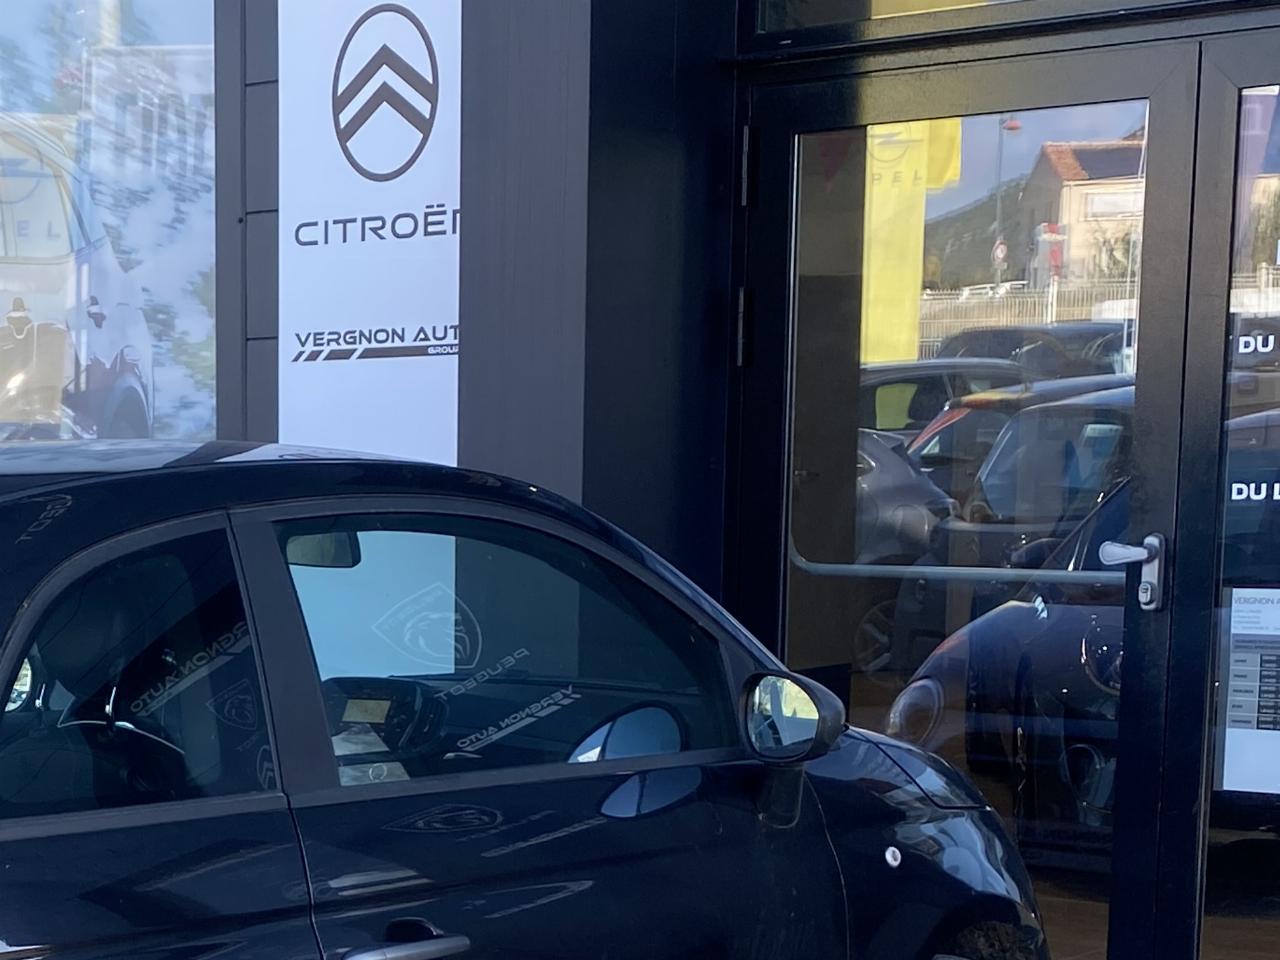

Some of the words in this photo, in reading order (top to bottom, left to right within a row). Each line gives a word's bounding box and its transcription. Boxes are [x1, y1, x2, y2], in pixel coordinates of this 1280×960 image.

[294, 326, 405, 348] VERGNON
[1238, 335, 1275, 353] DU
[1230, 482, 1267, 501] DU
